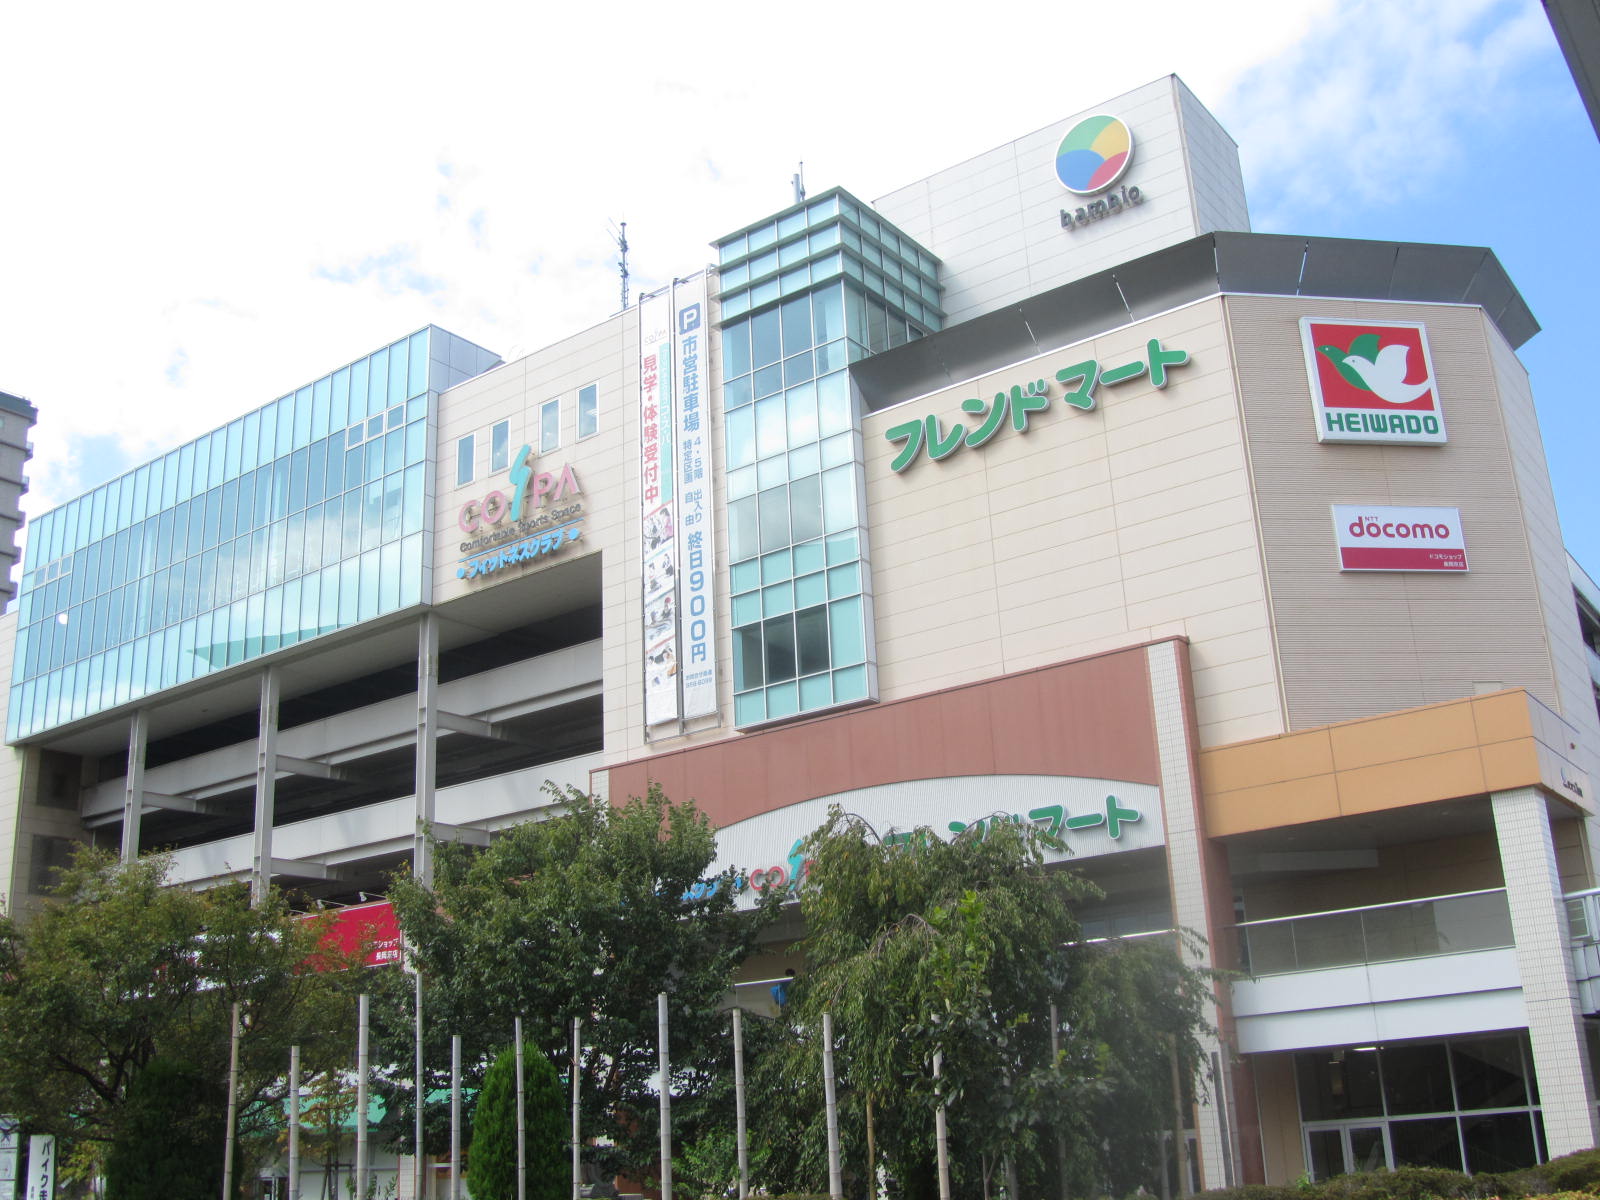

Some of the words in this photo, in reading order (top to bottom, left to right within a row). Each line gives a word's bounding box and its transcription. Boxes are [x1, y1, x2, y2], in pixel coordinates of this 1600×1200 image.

[682, 335, 699, 432] 市営駐車場
[885, 337, 1190, 473] フレンドマート
[643, 354, 659, 504] 見学・体験受付中
[1325, 412, 1440, 435] HEIWADO
[683, 439, 694, 484] 特定区画
[693, 488, 703, 524] 出入り
[1349, 516, 1450, 539] docomo
[468, 529, 565, 578] フィットネスクラブ
[688, 531, 706, 664] 終日900円
